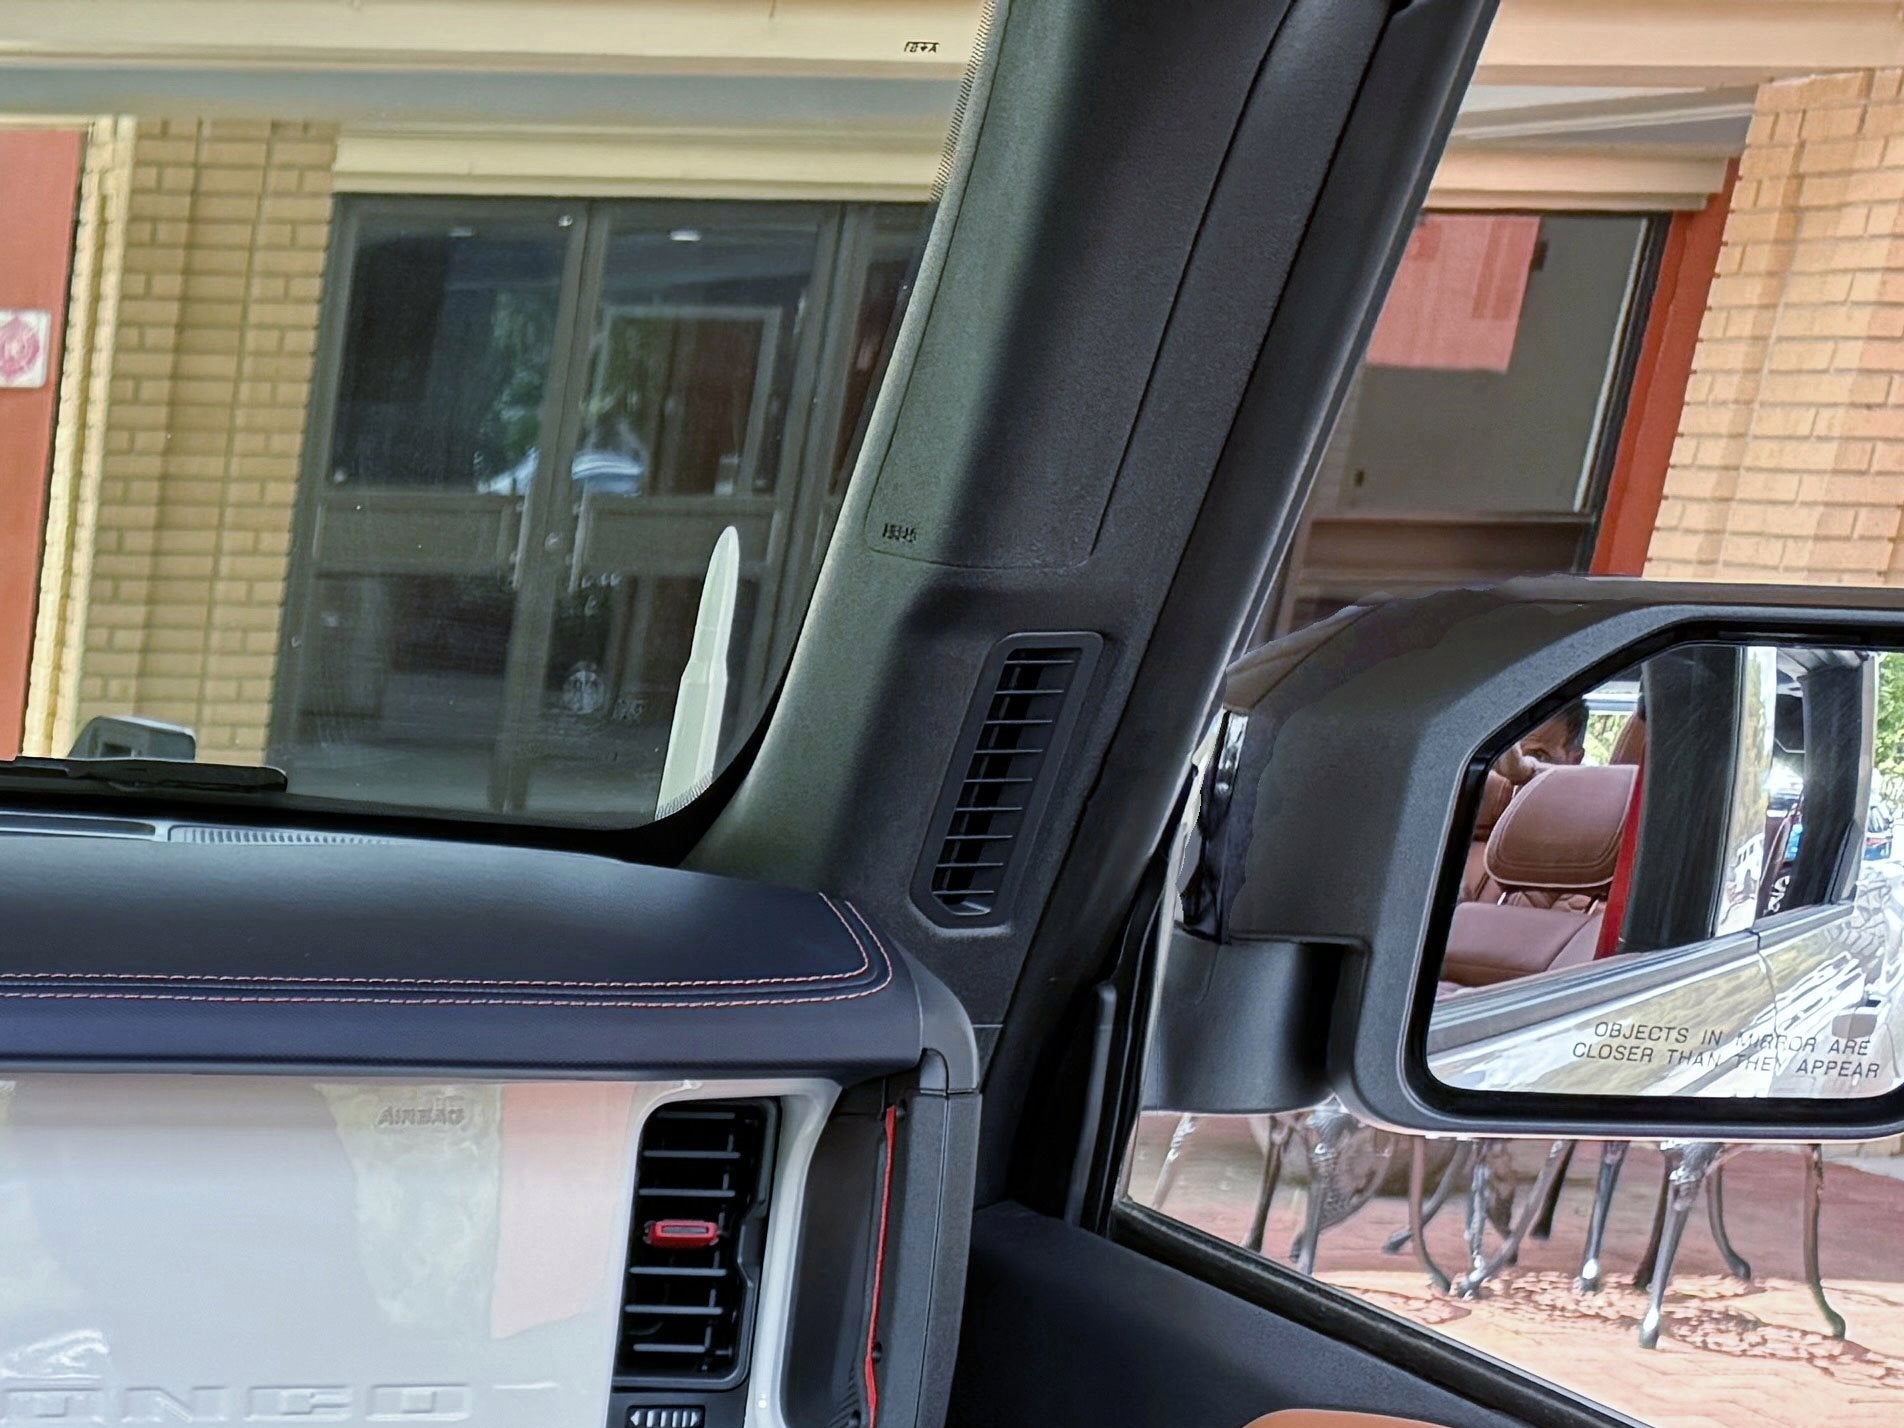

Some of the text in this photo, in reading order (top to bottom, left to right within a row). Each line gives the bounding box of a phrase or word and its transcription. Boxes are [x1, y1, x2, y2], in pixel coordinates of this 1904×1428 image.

[1594, 1021, 1871, 1056] OBJECTS IN MIRROR ARE
[1573, 1043, 1880, 1079] CLOSER THAN THEY APPEAR
[376, 1106, 464, 1126] AIRBAG
